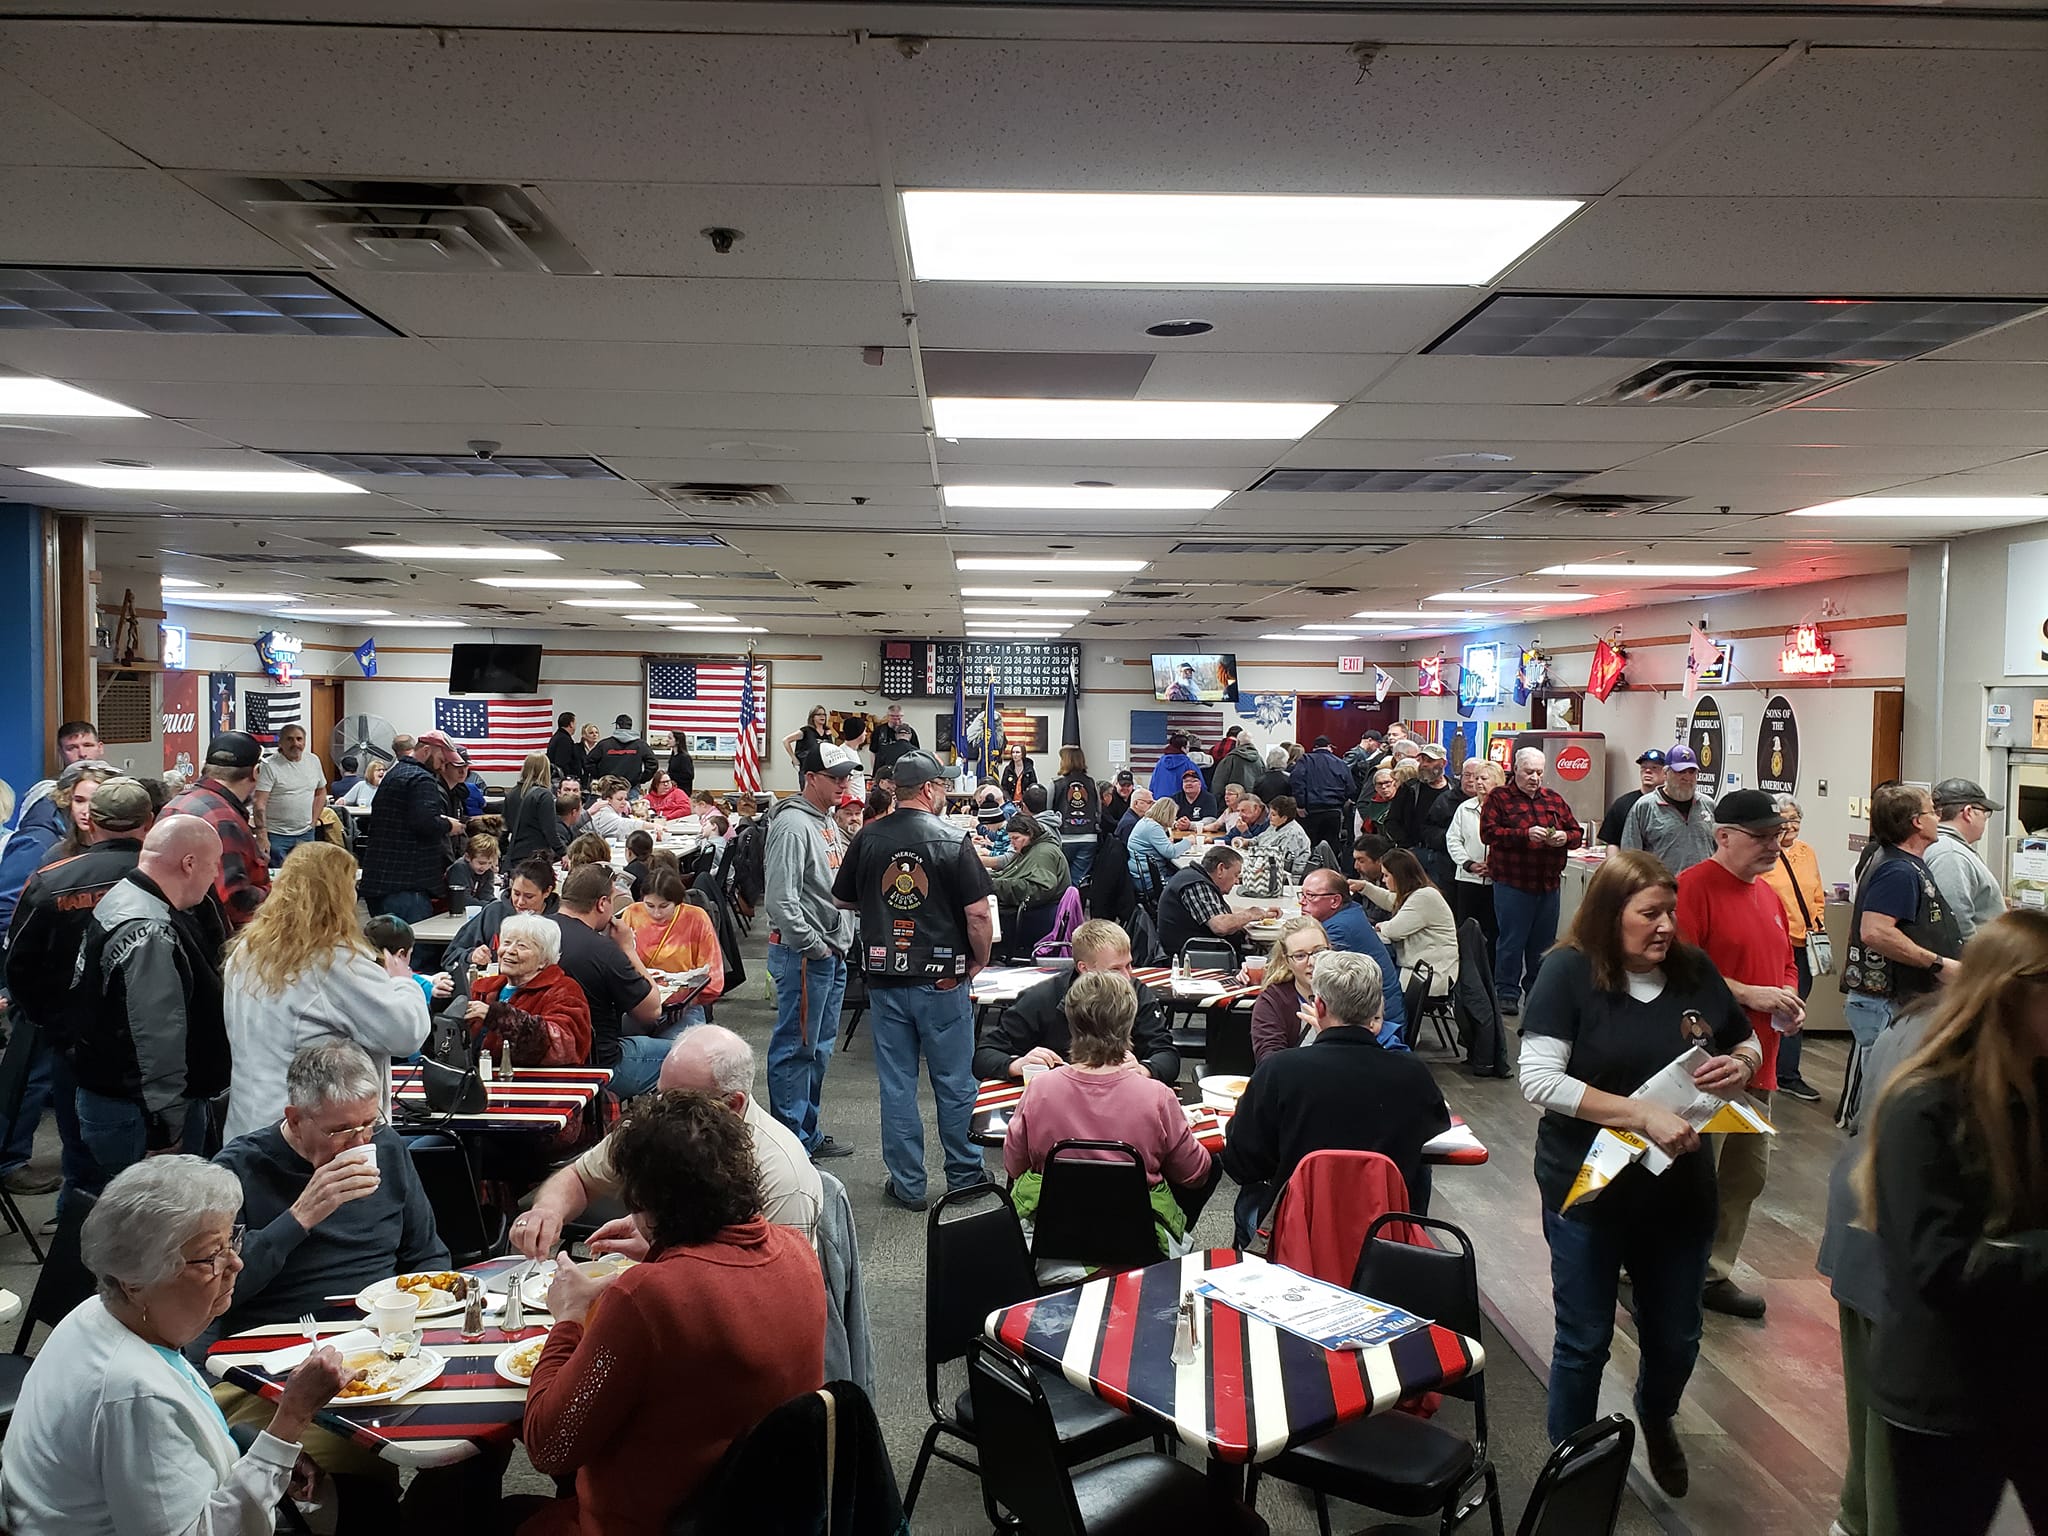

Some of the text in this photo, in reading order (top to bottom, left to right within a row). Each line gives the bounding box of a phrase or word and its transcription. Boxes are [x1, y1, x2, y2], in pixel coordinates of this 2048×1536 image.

[1023, 646, 1031, 654] 10
[1032, 646, 1040, 654] 11
[1042, 646, 1050, 654] 12
[1051, 646, 1060, 654] 13
[1061, 646, 1069, 654] 14
[1004, 656, 1012, 664] 23
[1013, 656, 1021, 664] 24
[1023, 656, 1031, 664] 25
[1032, 656, 1040, 664] 26
[1042, 656, 1050, 664] 27
[1051, 656, 1060, 664] 28
[1061, 656, 1069, 664] 29
[1343, 658, 1360, 671] EXIT
[946, 666, 954, 674] 32
[965, 666, 973, 674] 34
[974, 666, 982, 674] 35
[1004, 667, 1012, 675] 38
[1013, 667, 1021, 675] 39
[1023, 667, 1031, 675] 40
[1032, 667, 1040, 675] 41
[1042, 667, 1050, 675] 42
[1051, 667, 1060, 675] 43
[1061, 667, 1069, 675] 44
[946, 676, 954, 684] 47
[965, 676, 973, 684] 49
[974, 676, 982, 684] 50
[1004, 677, 1012, 685] 53
[1013, 677, 1021, 685] 54
[1023, 677, 1031, 685] 55
[1032, 677, 1040, 685] 56
[1042, 677, 1050, 685] 57
[1051, 677, 1060, 685] 58
[1061, 677, 1069, 685] 59
[946, 686, 954, 694] 62
[974, 686, 982, 694] 65
[1004, 687, 1012, 695] 68
[1013, 687, 1021, 695] 69
[1023, 687, 1031, 695] 70
[1032, 687, 1040, 695] 71
[1042, 687, 1050, 695] 72
[1051, 687, 1060, 695] 73
[1766, 709, 1792, 719] SONS OF
[1692, 719, 1720, 729] AMERICAN
[1771, 721, 1785, 731] THE
[1760, 779, 1793, 792] AMERICAN
[891, 851, 924, 864] AMERICAN
[924, 963, 945, 973] FTW
